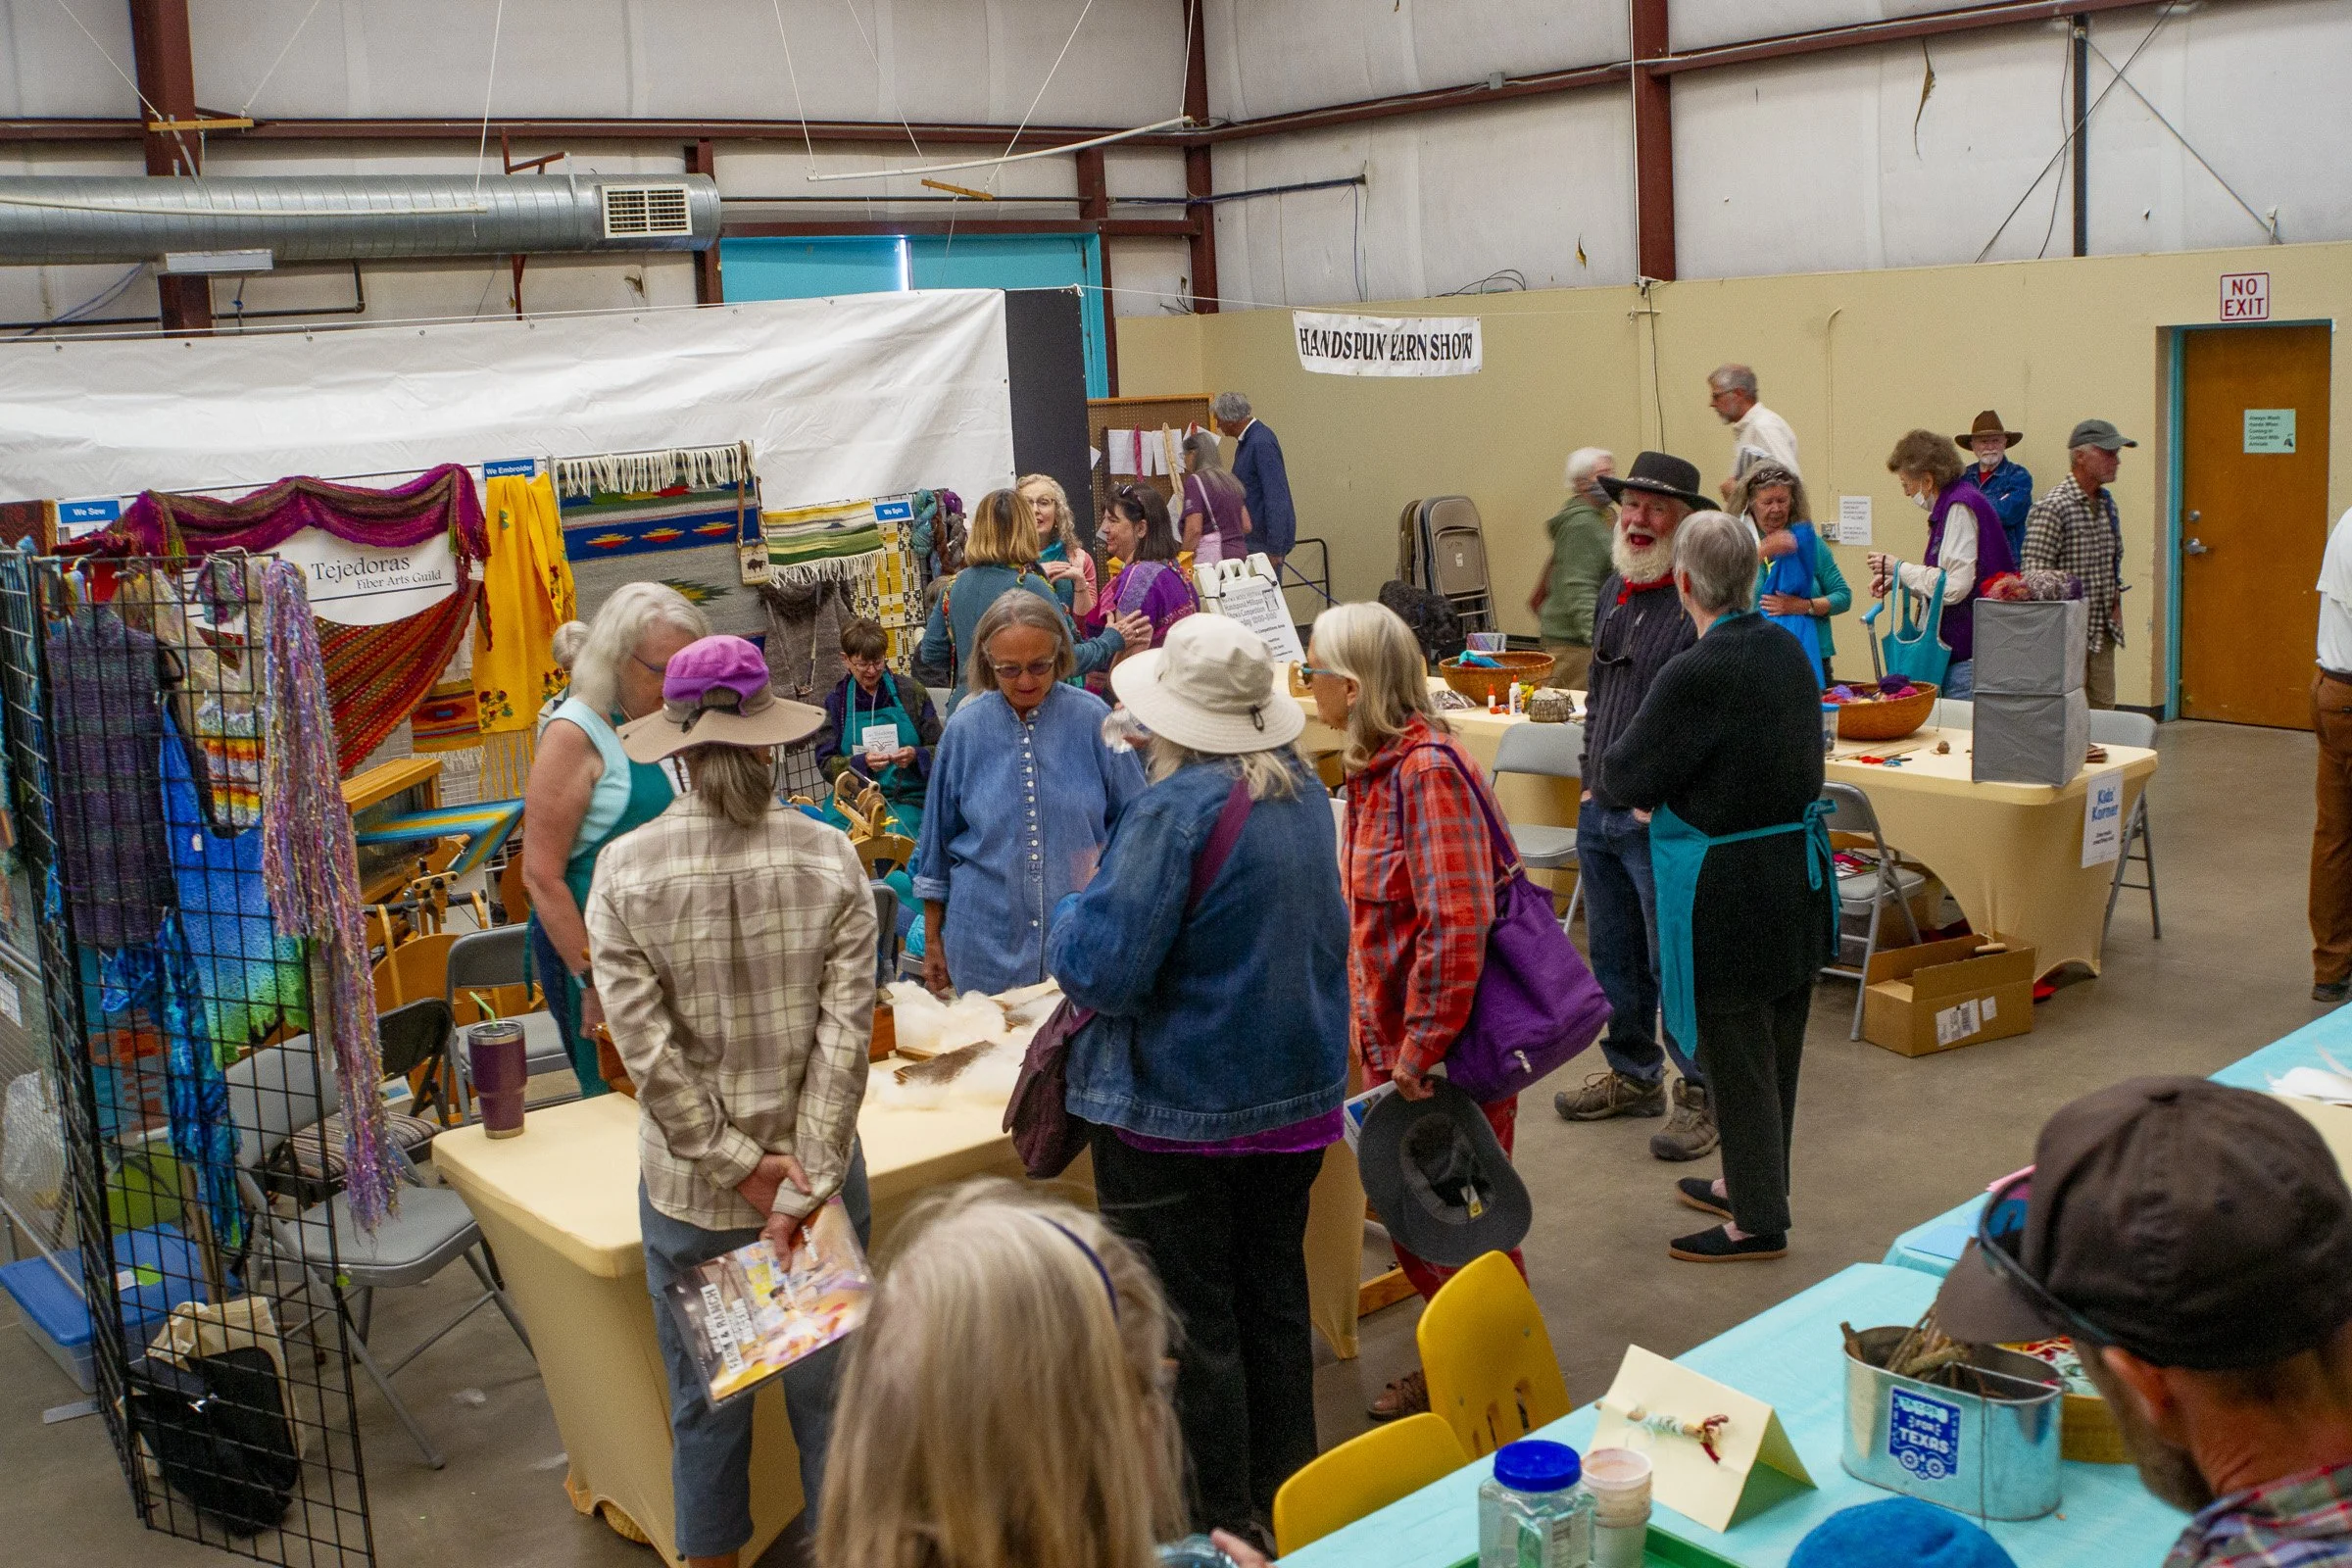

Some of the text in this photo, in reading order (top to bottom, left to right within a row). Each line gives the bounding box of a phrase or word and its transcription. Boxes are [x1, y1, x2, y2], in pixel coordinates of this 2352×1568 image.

[2232, 278, 2257, 295] NO
[2225, 298, 2265, 316] EXIT
[1298, 328, 1472, 362] HANDSPUN YARN SHOW
[498, 465, 533, 473] Embroider
[87, 507, 106, 515] Sew
[311, 557, 410, 583] Tejedoras
[357, 569, 441, 590] Fiber Arts Guild
[2091, 804, 2119, 822] Korner
[705, 1289, 727, 1329] RANCH
[1898, 1427, 1950, 1454] TEXAS
